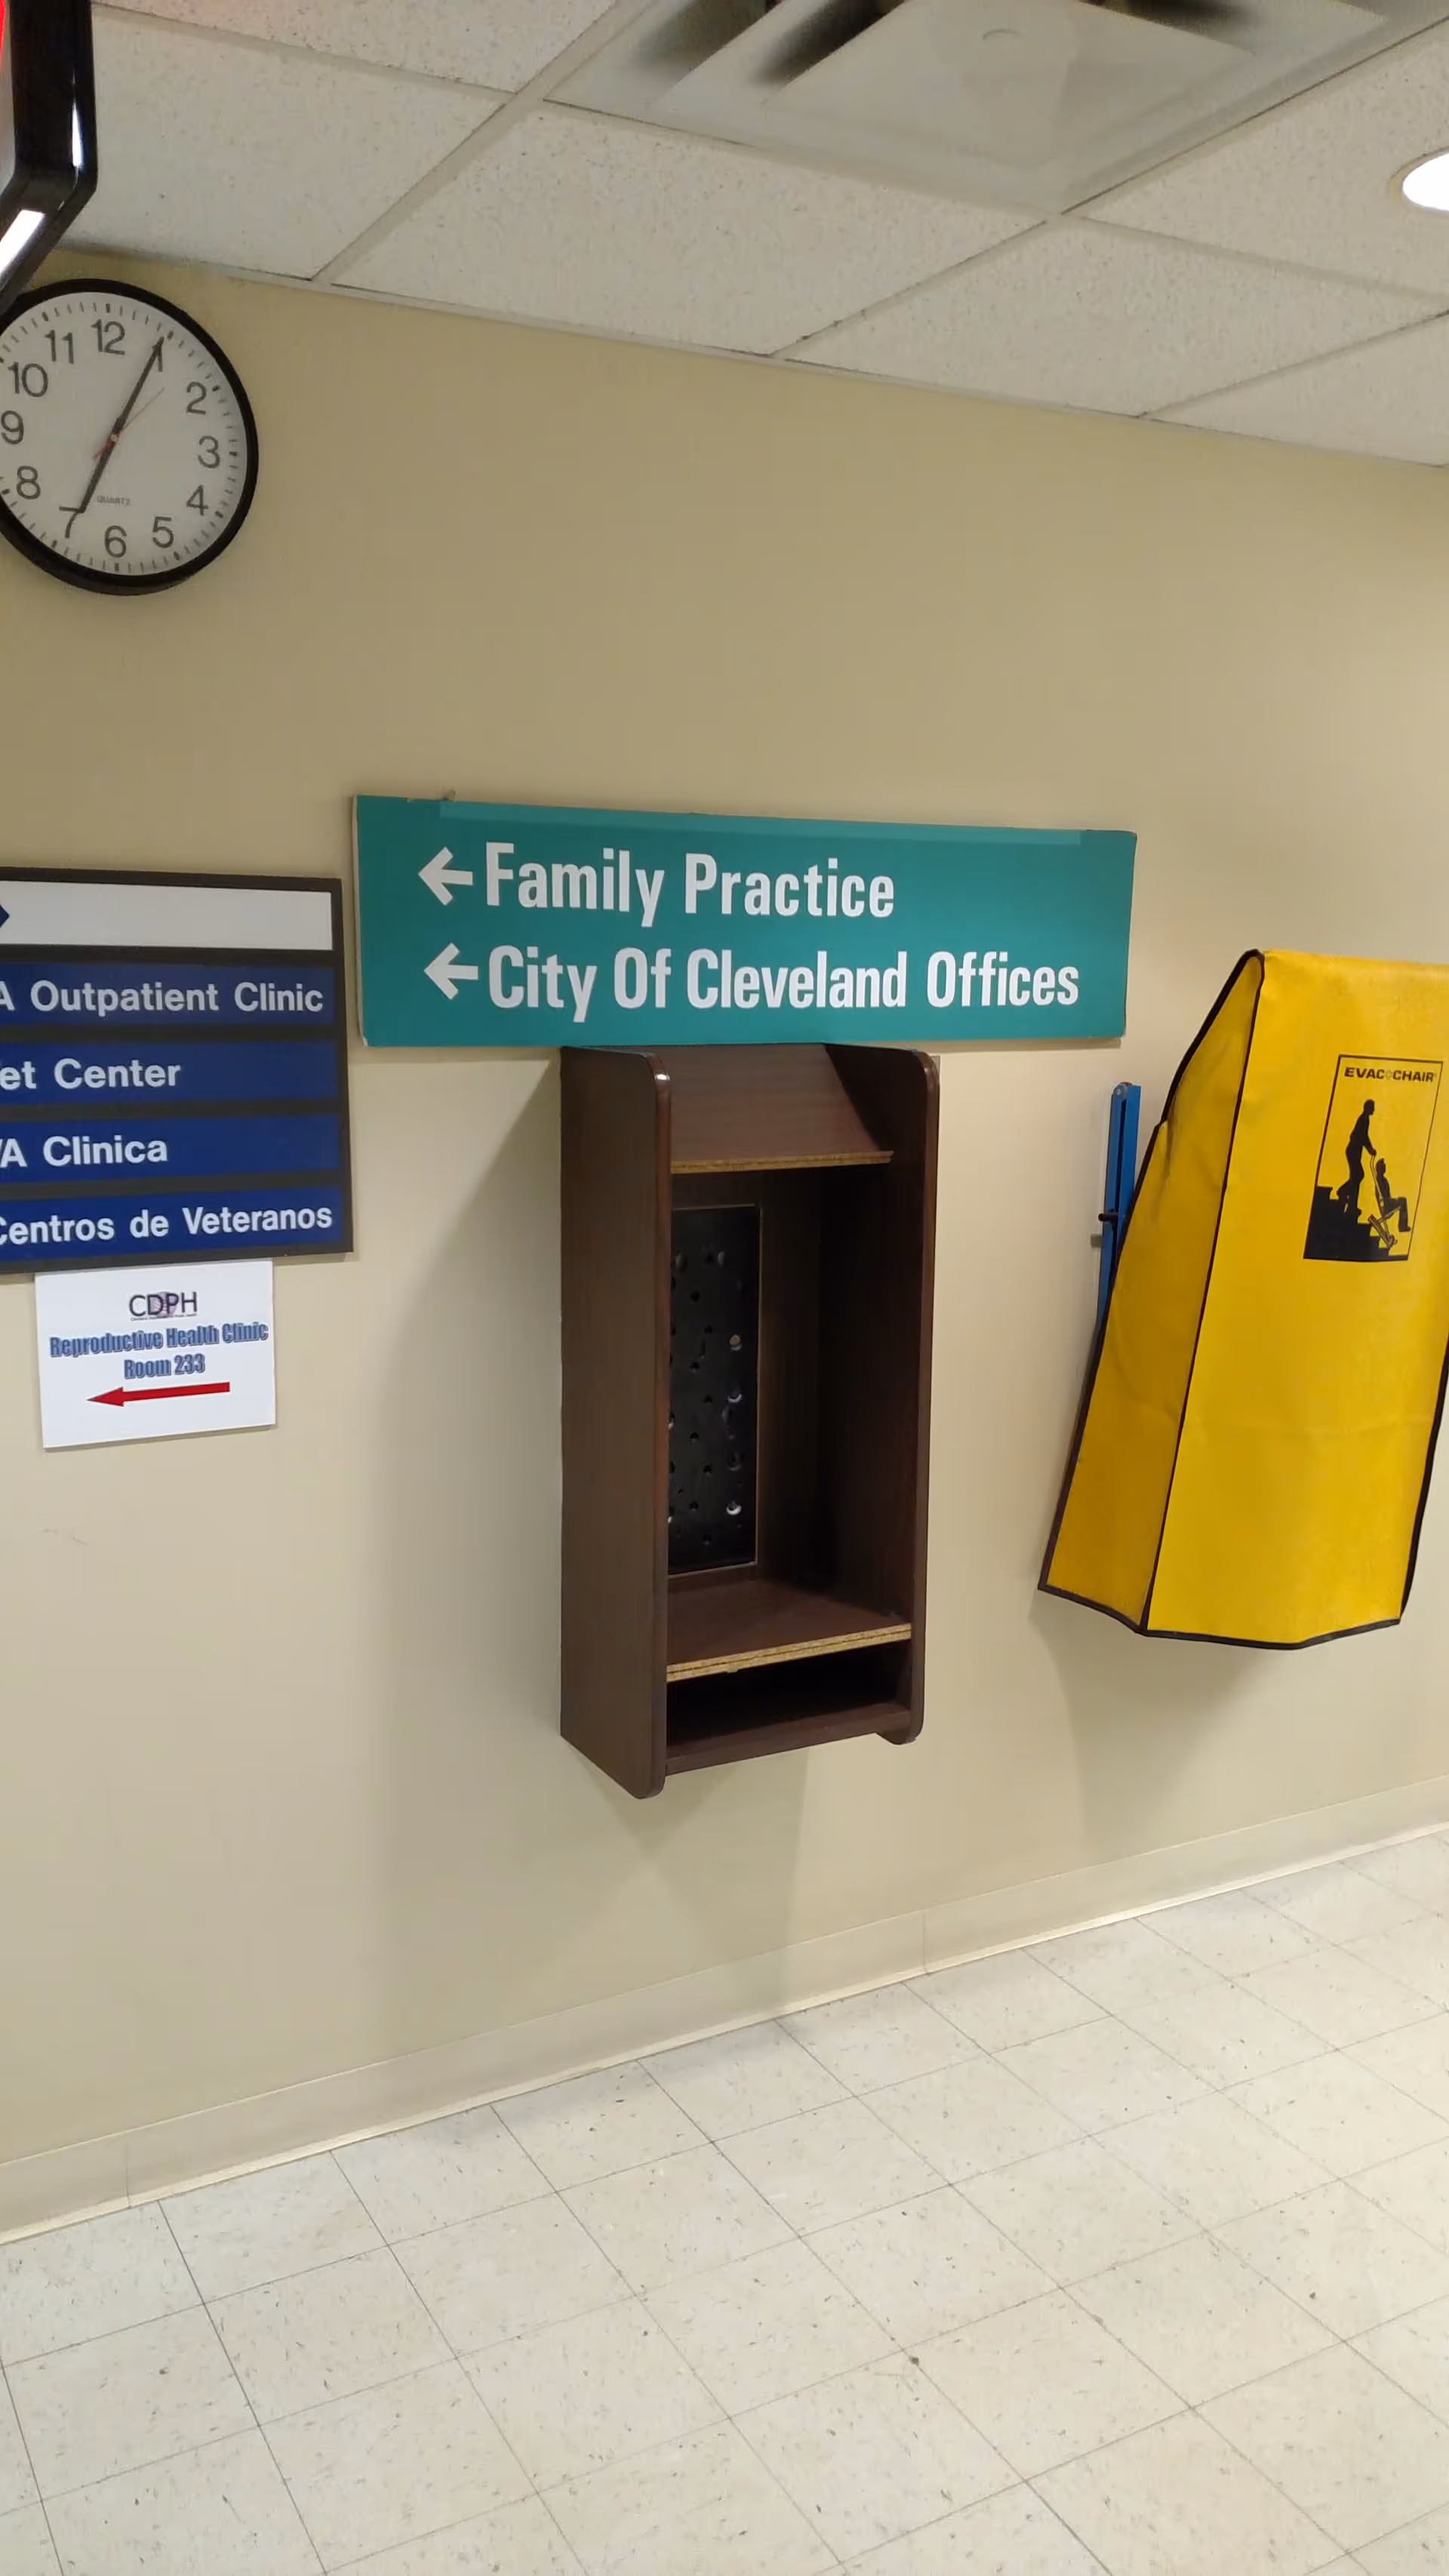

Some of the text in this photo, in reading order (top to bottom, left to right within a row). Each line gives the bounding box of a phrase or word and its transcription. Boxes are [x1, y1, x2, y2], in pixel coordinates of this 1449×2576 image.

[45, 330, 74, 364] 11
[91, 319, 126, 355] 12
[8, 362, 49, 397] 10
[186, 381, 207, 414] 2
[1, 410, 24, 445] 9
[197, 435, 220, 469] 3
[16, 466, 41, 500] 8
[186, 485, 208, 516] 4
[59, 506, 84, 538] 7
[152, 516, 174, 548] 5
[104, 525, 127, 558] 6
[486, 842, 894, 928] Family Practice
[31, 980, 218, 1017] Outpatient
[234, 982, 324, 1012] Clinic
[488, 945, 1079, 1023] City Of Cleveland Offices
[54, 1058, 181, 1089] Center
[43, 1134, 168, 1167] Clinica
[130, 1209, 169, 1239] de
[182, 1206, 333, 1235] Veteranos
[129, 1291, 198, 1317] CDPH
[49, 1322, 269, 1358] Reproductive Health Clinic
[124, 1353, 206, 1380] Room 233
